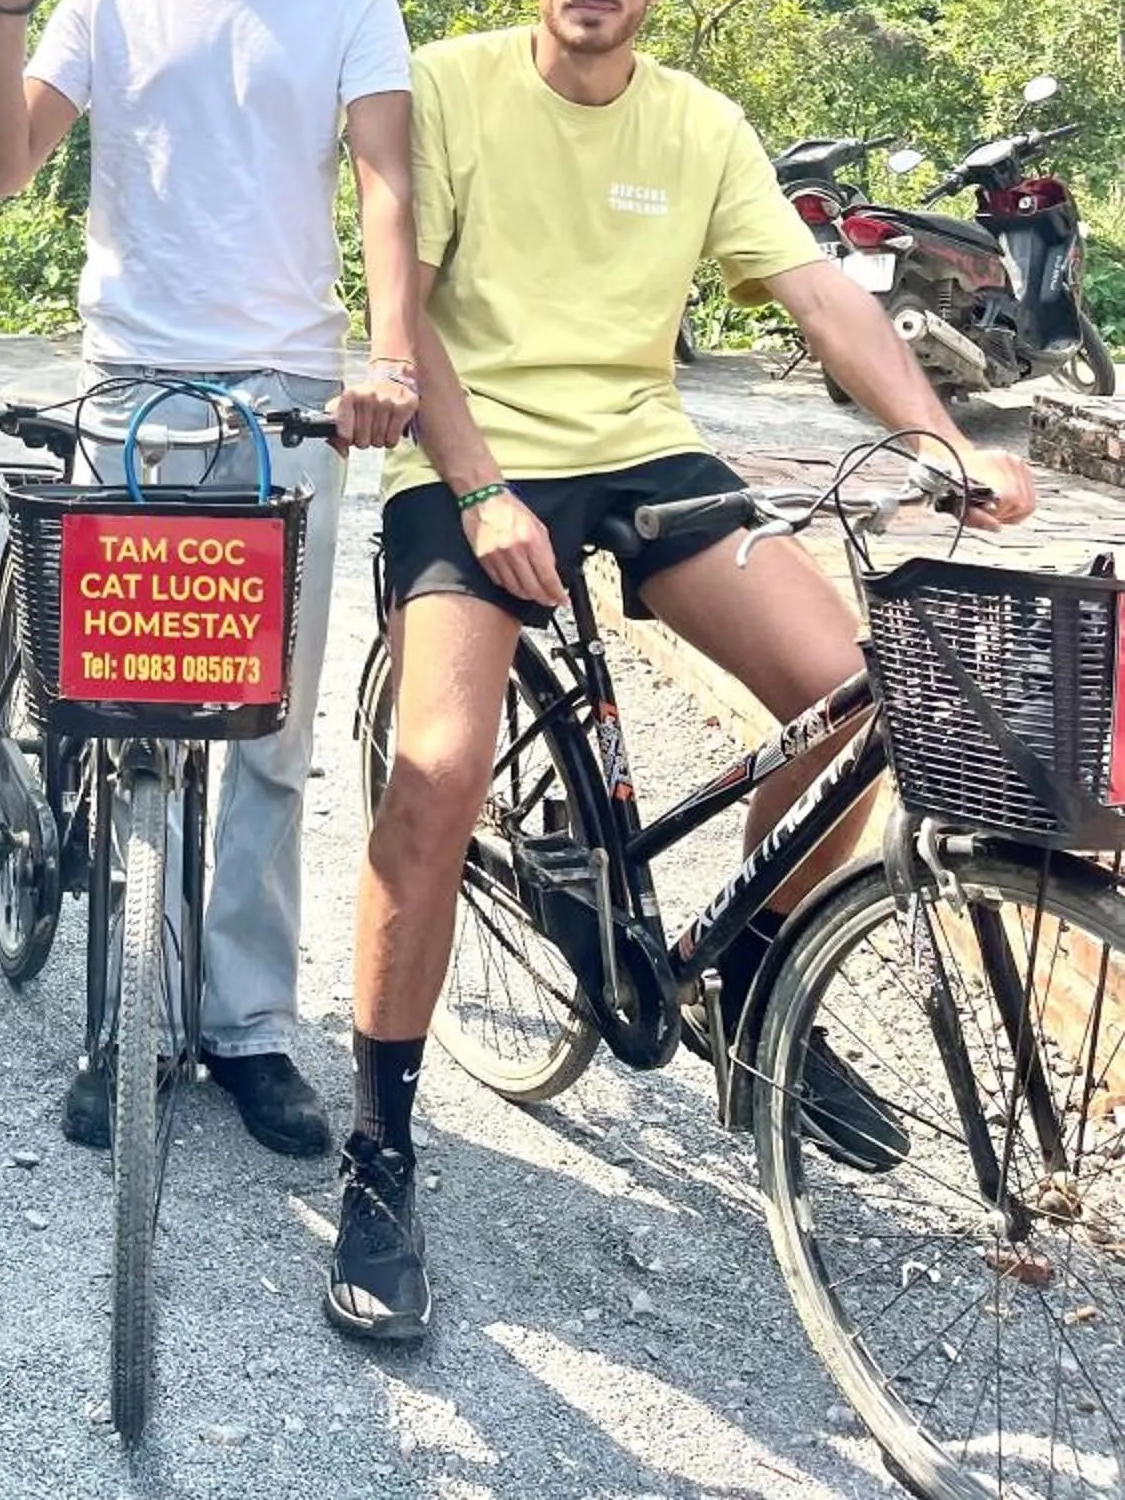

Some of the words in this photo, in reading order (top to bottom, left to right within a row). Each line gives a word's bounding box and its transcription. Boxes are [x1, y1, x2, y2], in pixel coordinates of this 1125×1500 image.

[99, 535, 168, 563] TAM
[177, 537, 246, 565] COC
[80, 573, 142, 599] CAT
[152, 574, 264, 603] LUONG
[84, 609, 260, 639] HOMESTAY
[81, 651, 118, 680] Tel:
[123, 653, 176, 682] 0983
[182, 655, 261, 684] 085673
